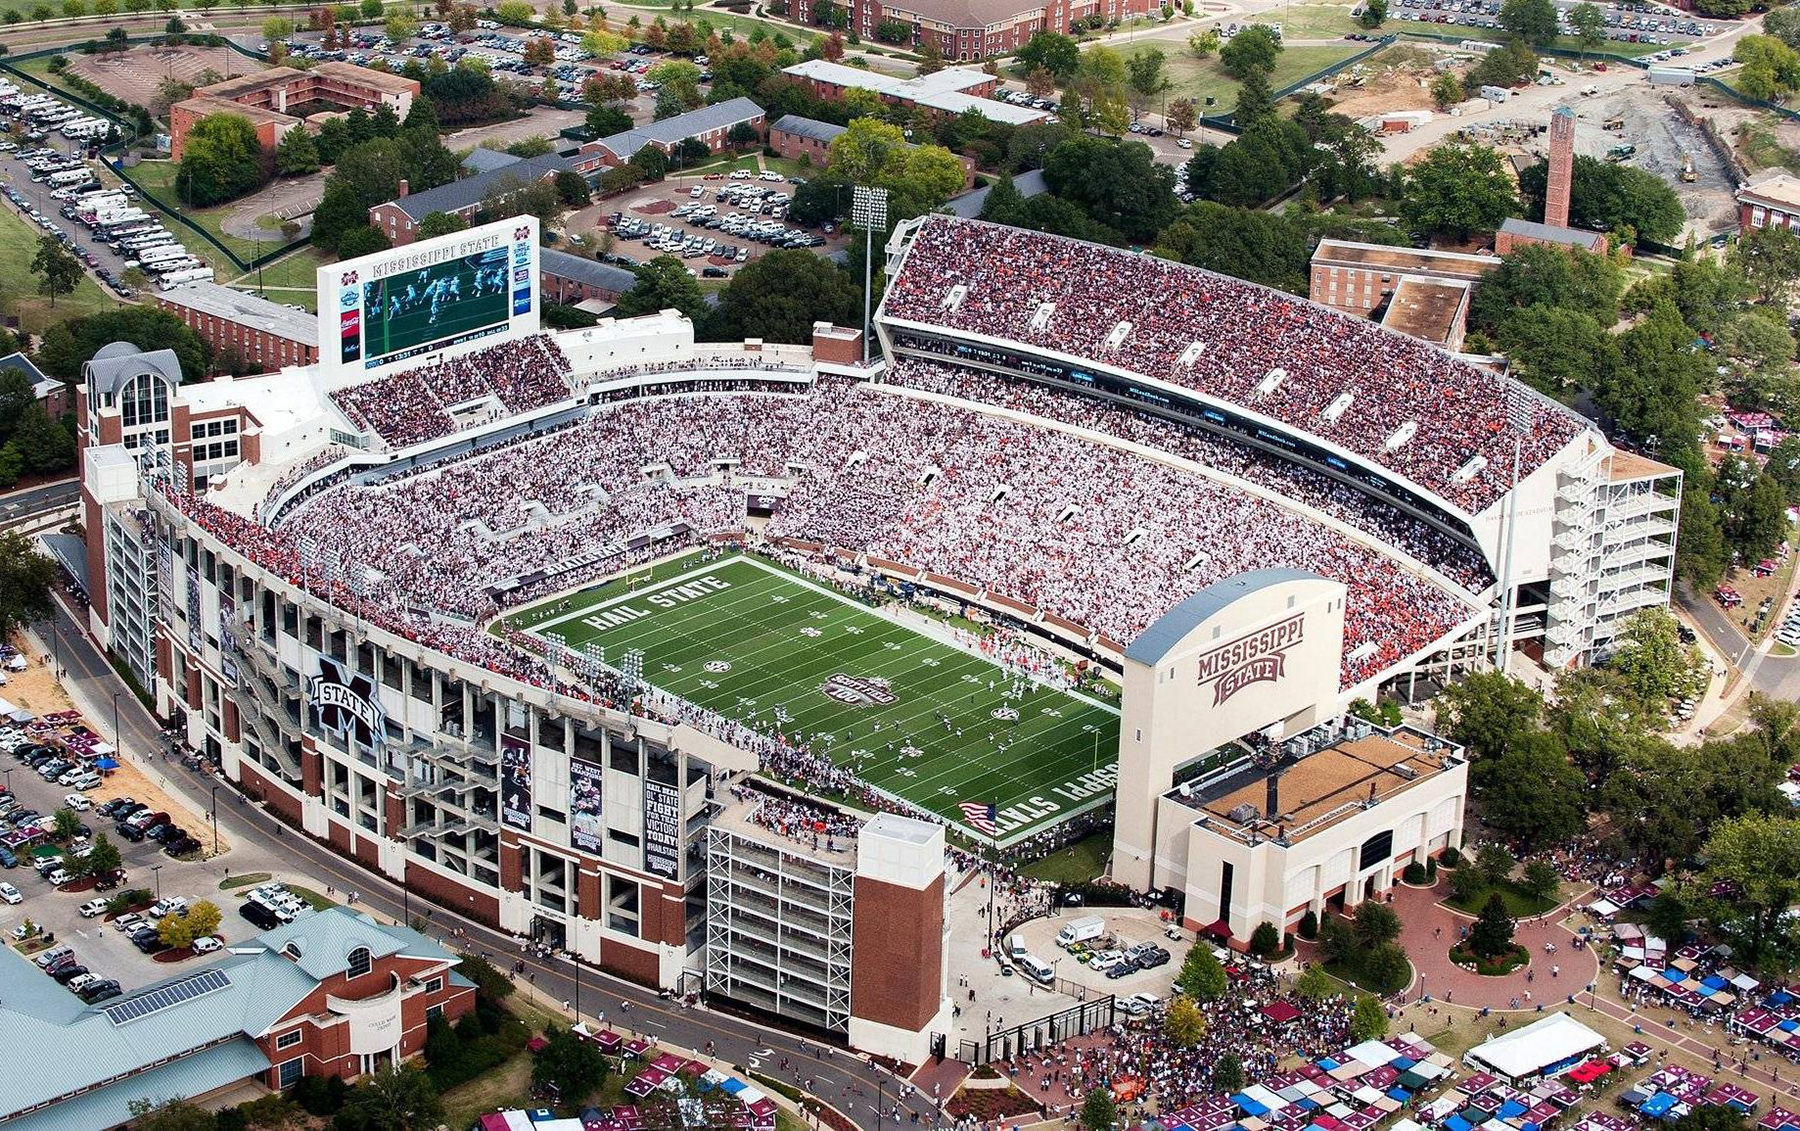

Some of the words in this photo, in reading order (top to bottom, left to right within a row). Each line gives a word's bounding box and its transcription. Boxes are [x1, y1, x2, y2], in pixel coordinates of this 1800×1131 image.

[373, 245, 456, 277] MISSISSIPPI
[460, 235, 500, 255] STATE
[582, 605, 653, 631] HAIL
[647, 575, 733, 608] STATE
[1198, 617, 1305, 681] MISSISSIPPI
[1224, 660, 1274, 697] STATE
[829, 689, 861, 702] 100
[831, 675, 868, 690] SCOTT
[862, 687, 895, 703] FIELD
[323, 685, 369, 722] STATE
[647, 782, 661, 792] HAIL
[647, 790, 657, 800] OL'
[658, 793, 678, 806] STATE
[647, 800, 678, 817] FIGHT
[647, 811, 660, 820] FOR
[660, 814, 678, 825] THAT
[647, 818, 678, 837] VICTORY
[647, 830, 678, 847] TODAY!
[647, 842, 678, 858] #HAILSTATE
